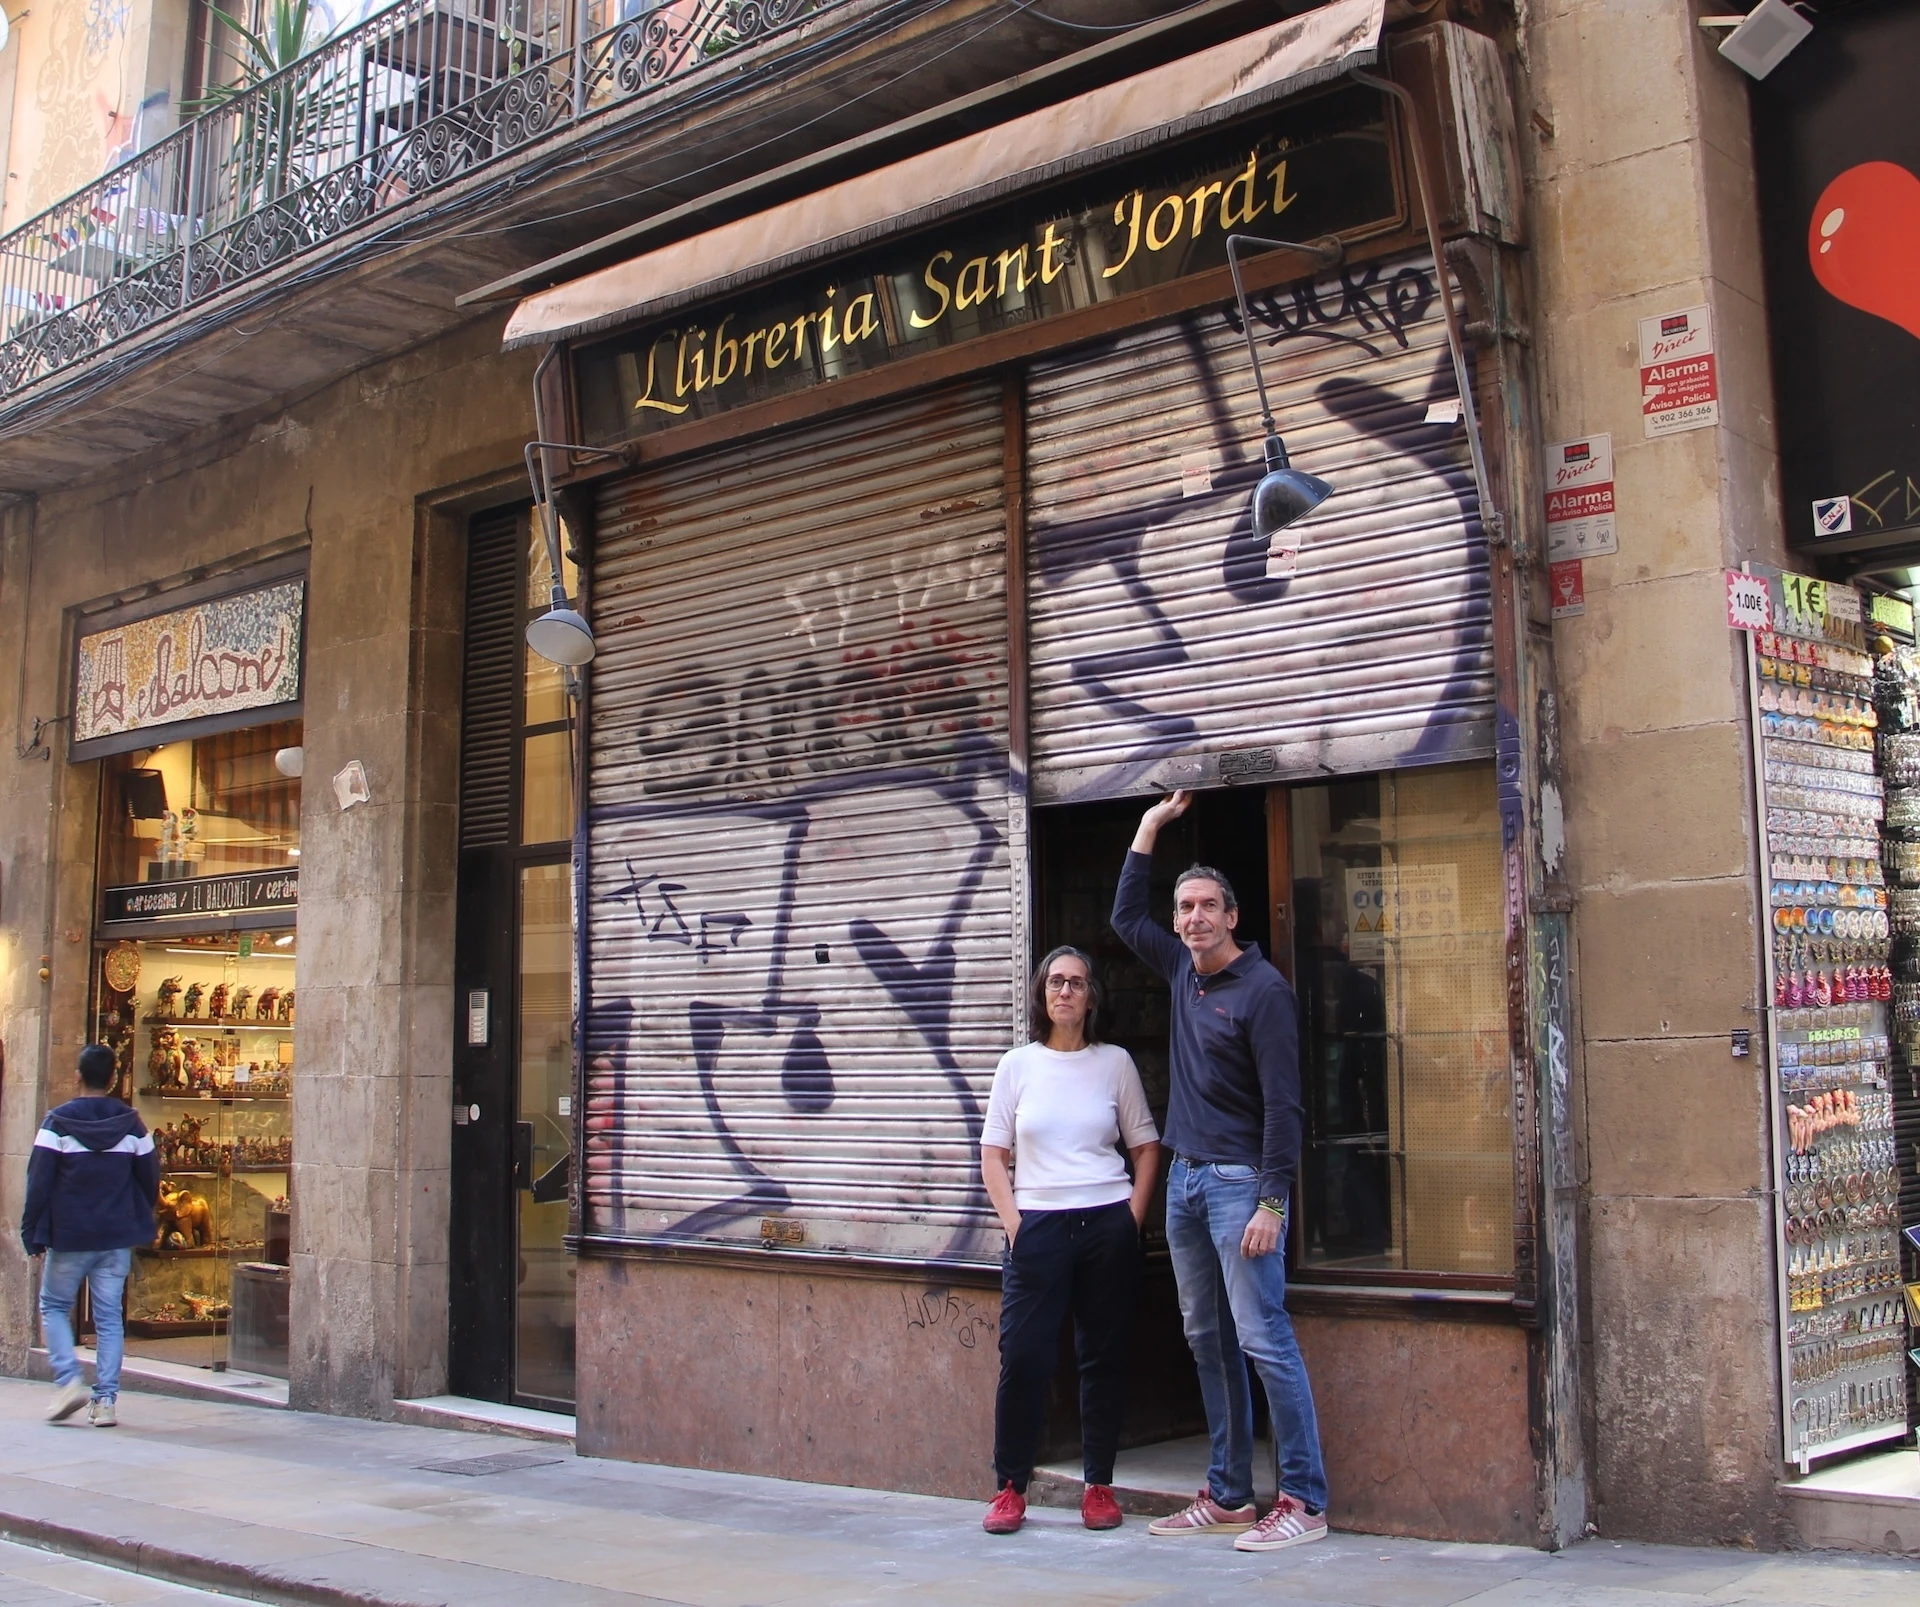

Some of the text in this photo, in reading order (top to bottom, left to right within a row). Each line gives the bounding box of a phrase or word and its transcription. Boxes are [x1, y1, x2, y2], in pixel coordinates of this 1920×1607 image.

[634, 135, 1297, 414] Llibreria Sant Jordi
[1652, 327, 1702, 359] Direct
[1648, 361, 1709, 382] Alarma
[1679, 374, 1709, 386] grabación
[1678, 381, 1710, 392] imágenes
[1650, 401, 1673, 411] Aviso
[1683, 392, 1711, 404] Policía
[1660, 406, 1711, 422] 902 366 366
[1556, 456, 1602, 485] Direct
[1548, 490, 1612, 511] Alarma
[1562, 508, 1581, 518] Aviso
[1589, 502, 1612, 512] Policía
[1736, 592, 1762, 611] 1.00€
[1790, 577, 1823, 618] 1€
[192, 885, 202, 911] EL
[207, 880, 250, 908] BALCONET
